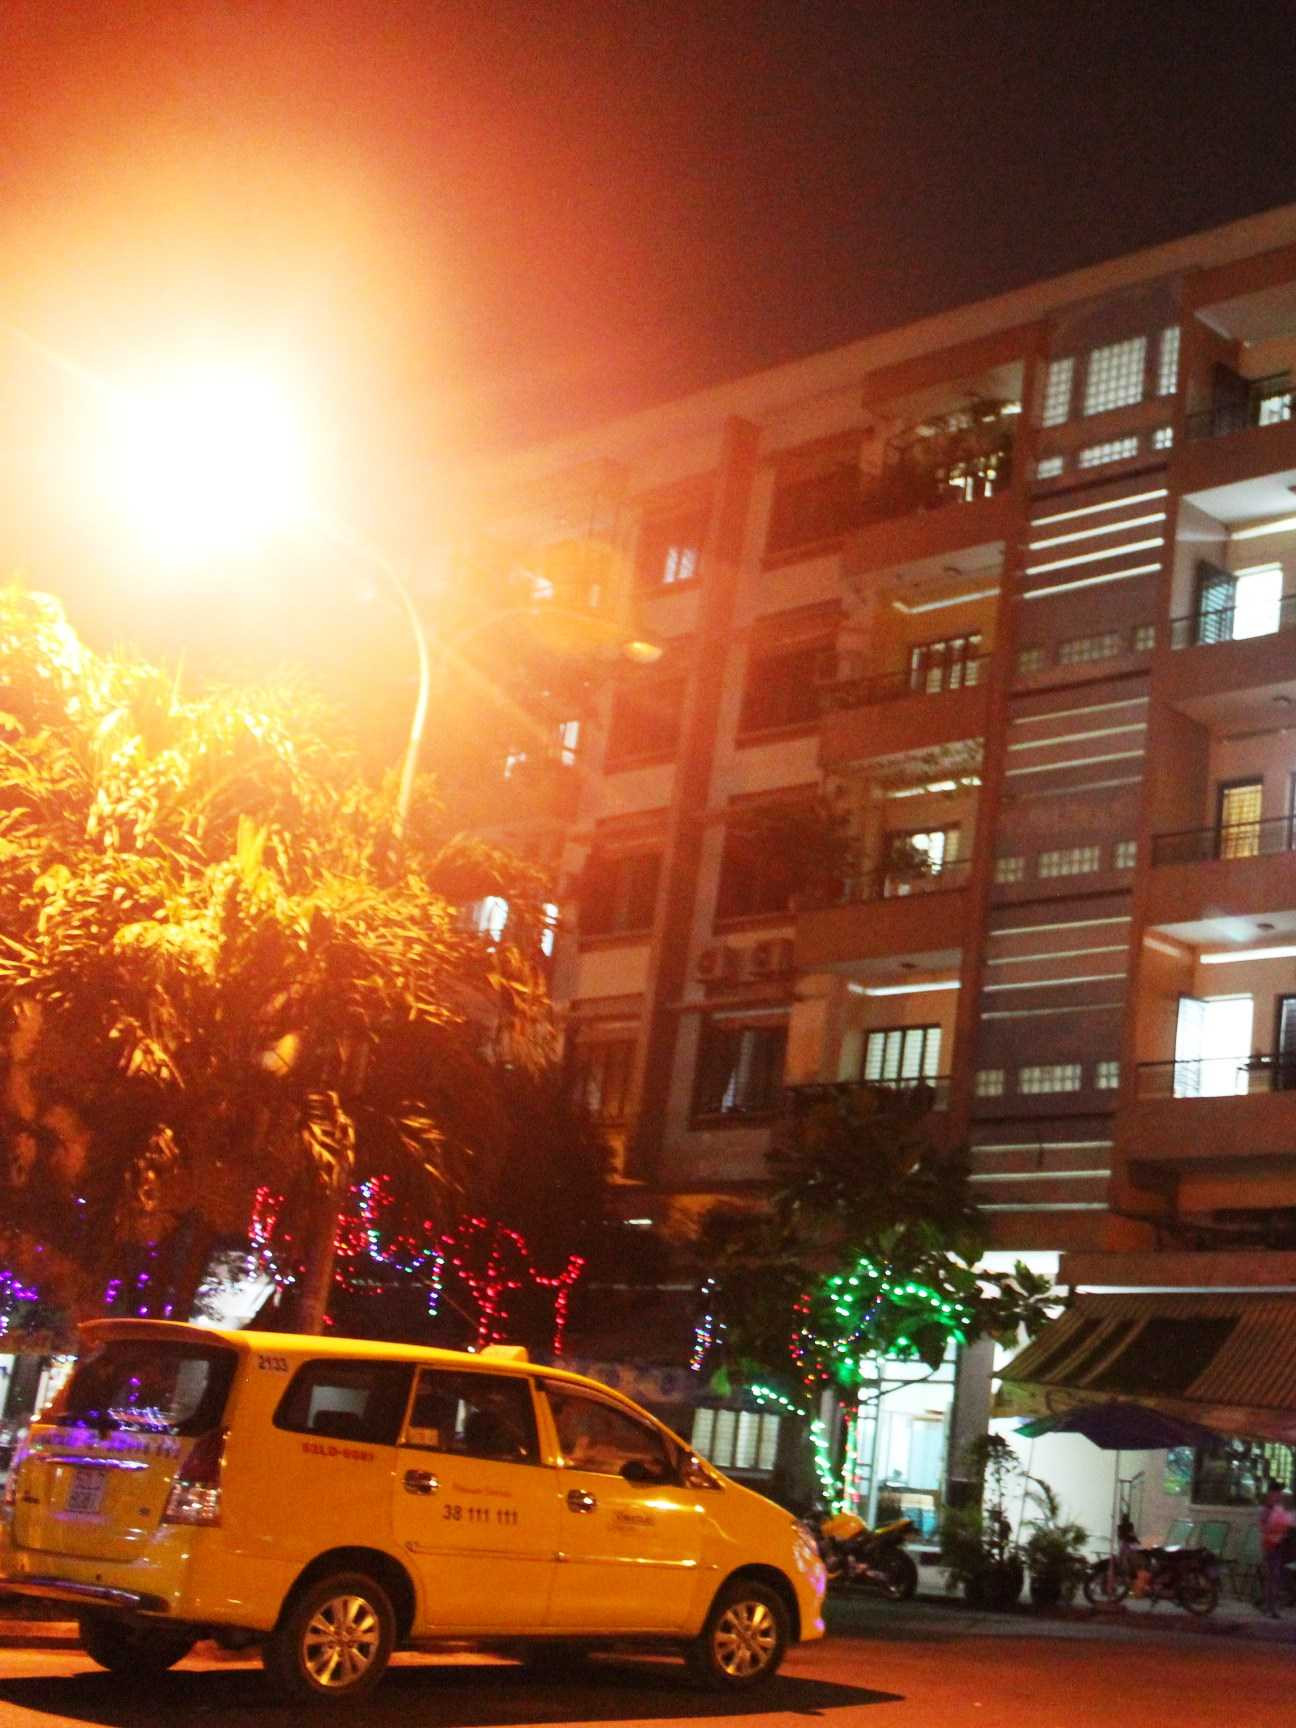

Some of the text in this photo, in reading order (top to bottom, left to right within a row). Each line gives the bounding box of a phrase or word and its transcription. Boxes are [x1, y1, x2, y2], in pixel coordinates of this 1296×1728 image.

[443, 1504, 518, 1525] 38 111 111
